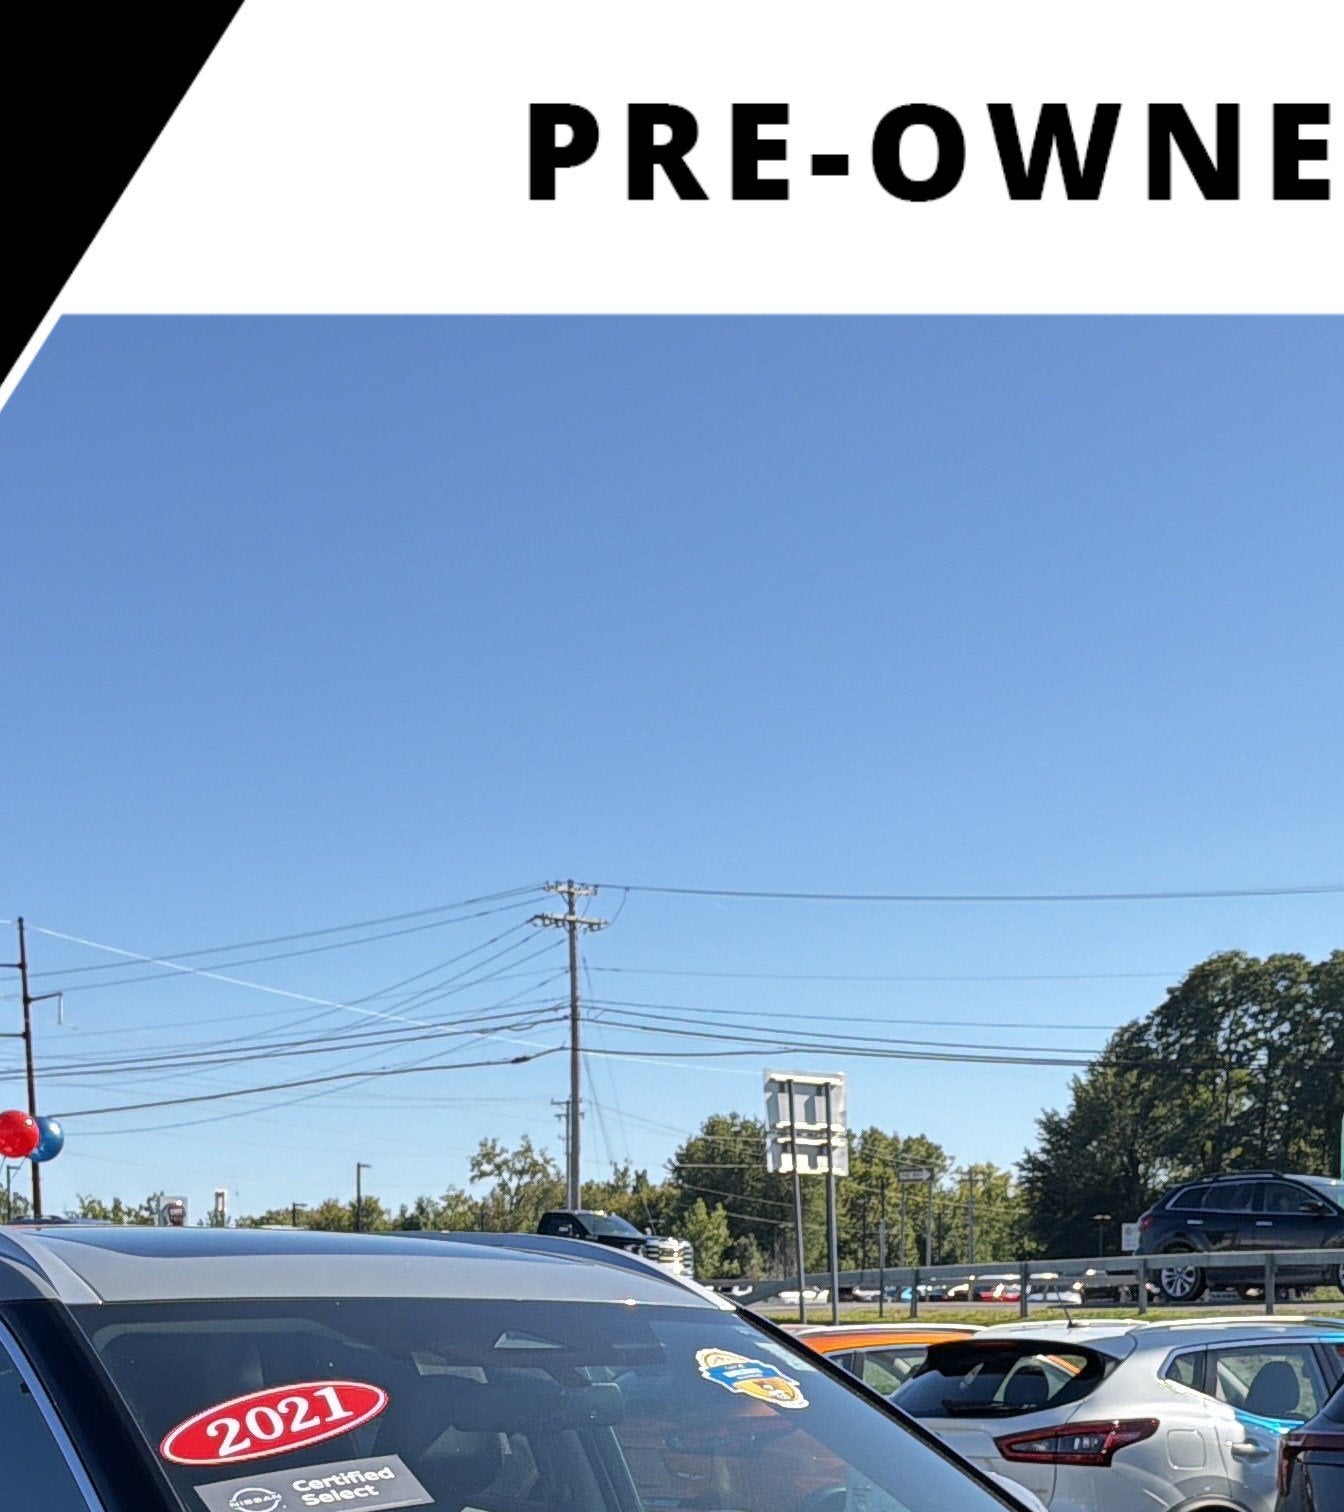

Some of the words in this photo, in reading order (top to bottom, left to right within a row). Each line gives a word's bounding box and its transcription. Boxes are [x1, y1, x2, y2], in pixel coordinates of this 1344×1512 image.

[206, 1386, 354, 1457] 2021
[292, 1466, 395, 1493] Certified
[301, 1484, 380, 1506] Select
